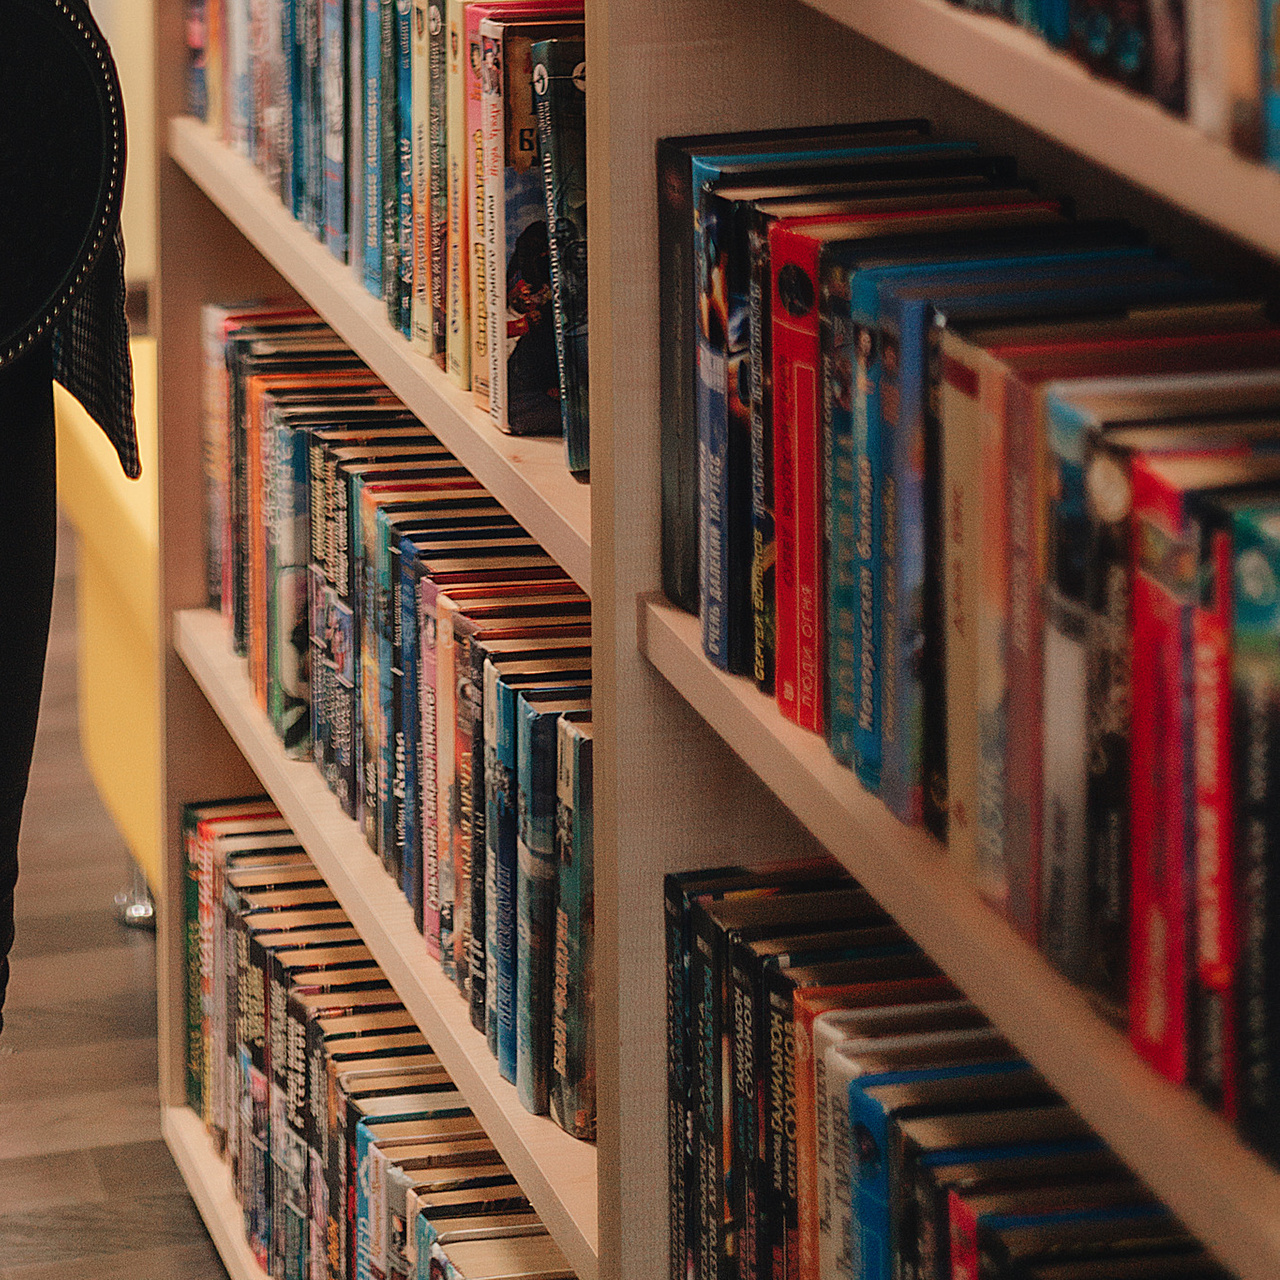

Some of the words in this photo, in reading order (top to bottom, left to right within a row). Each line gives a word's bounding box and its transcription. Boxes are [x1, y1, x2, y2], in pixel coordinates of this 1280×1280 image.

[801, 583, 814, 638] ОГНЯ
[801, 646, 814, 707] ЛЮДИ
[734, 986, 745, 1092] ГАМИЛЬТОН
[743, 995, 754, 1099] СУХИНОВ
[770, 1011, 784, 1133] ГАМИЛЬТОН
[784, 1020, 796, 1139] СУХИНОВ
